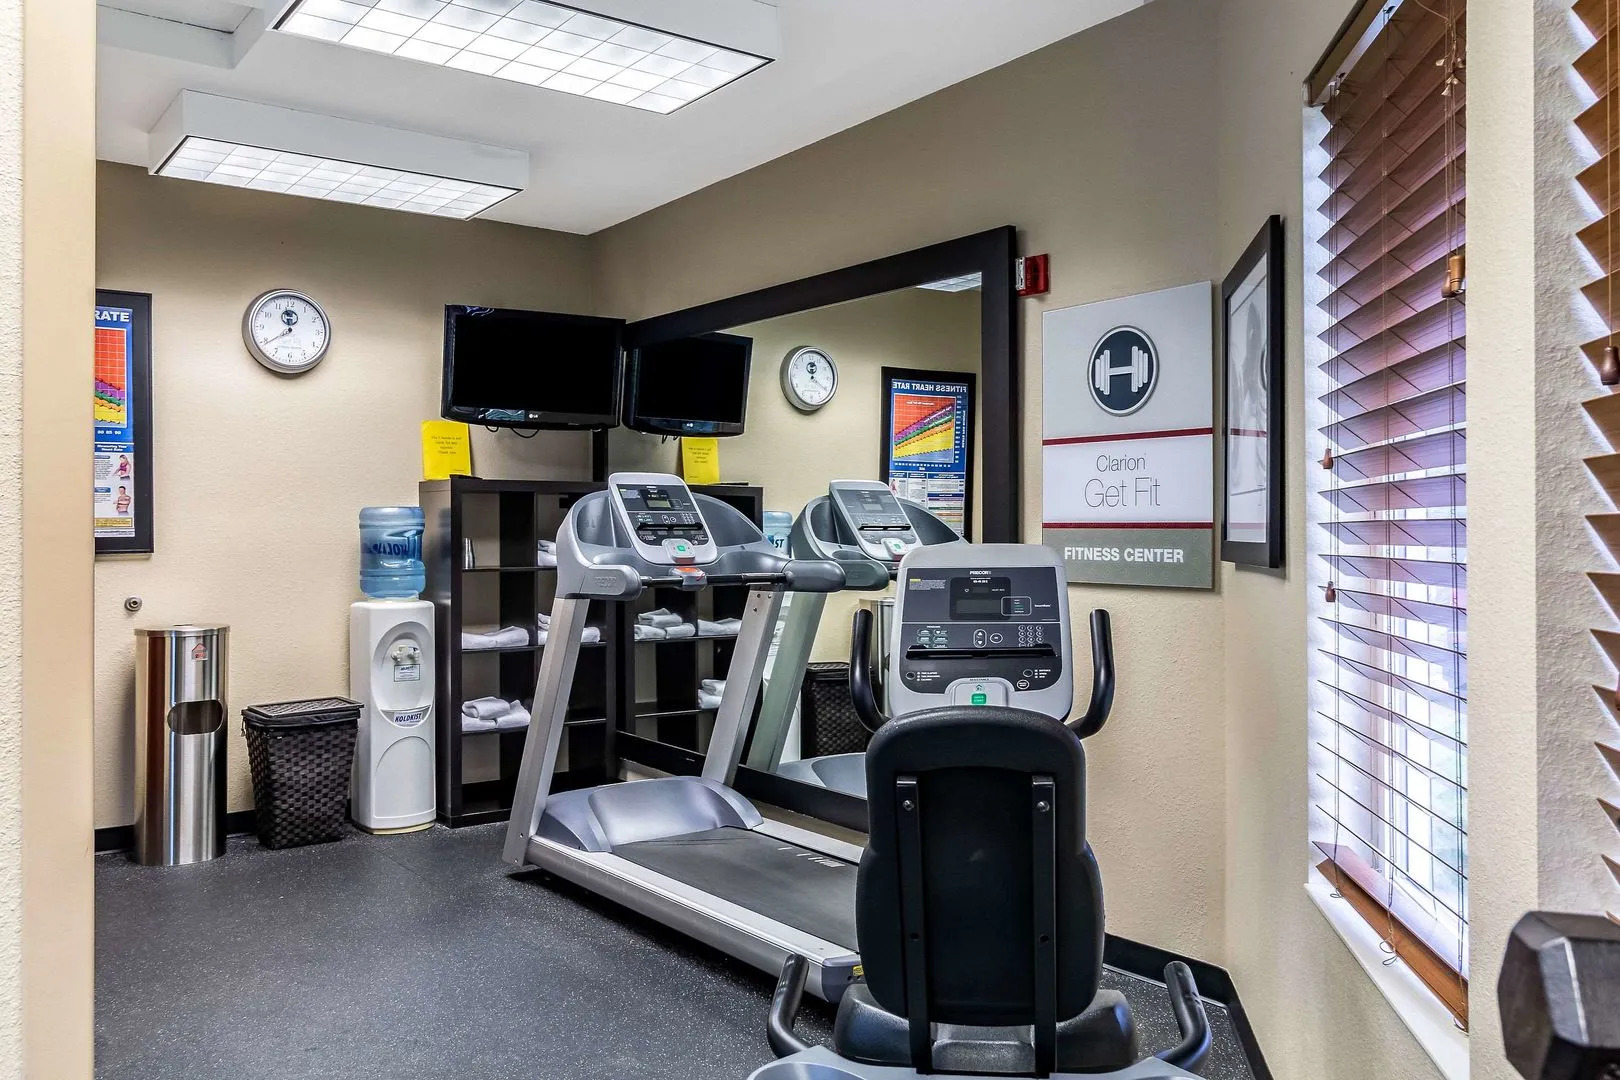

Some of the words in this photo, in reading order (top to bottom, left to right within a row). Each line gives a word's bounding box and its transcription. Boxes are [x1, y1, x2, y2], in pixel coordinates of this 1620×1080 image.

[286, 300, 295, 308] 12
[1096, 453, 1146, 473] Clarion
[1084, 478, 1128, 509] Get
[1134, 476, 1161, 507] Fit
[1064, 546, 1120, 562] FITNESS
[1123, 547, 1185, 563] CENTER
[394, 712, 423, 724] KOLDKIST
